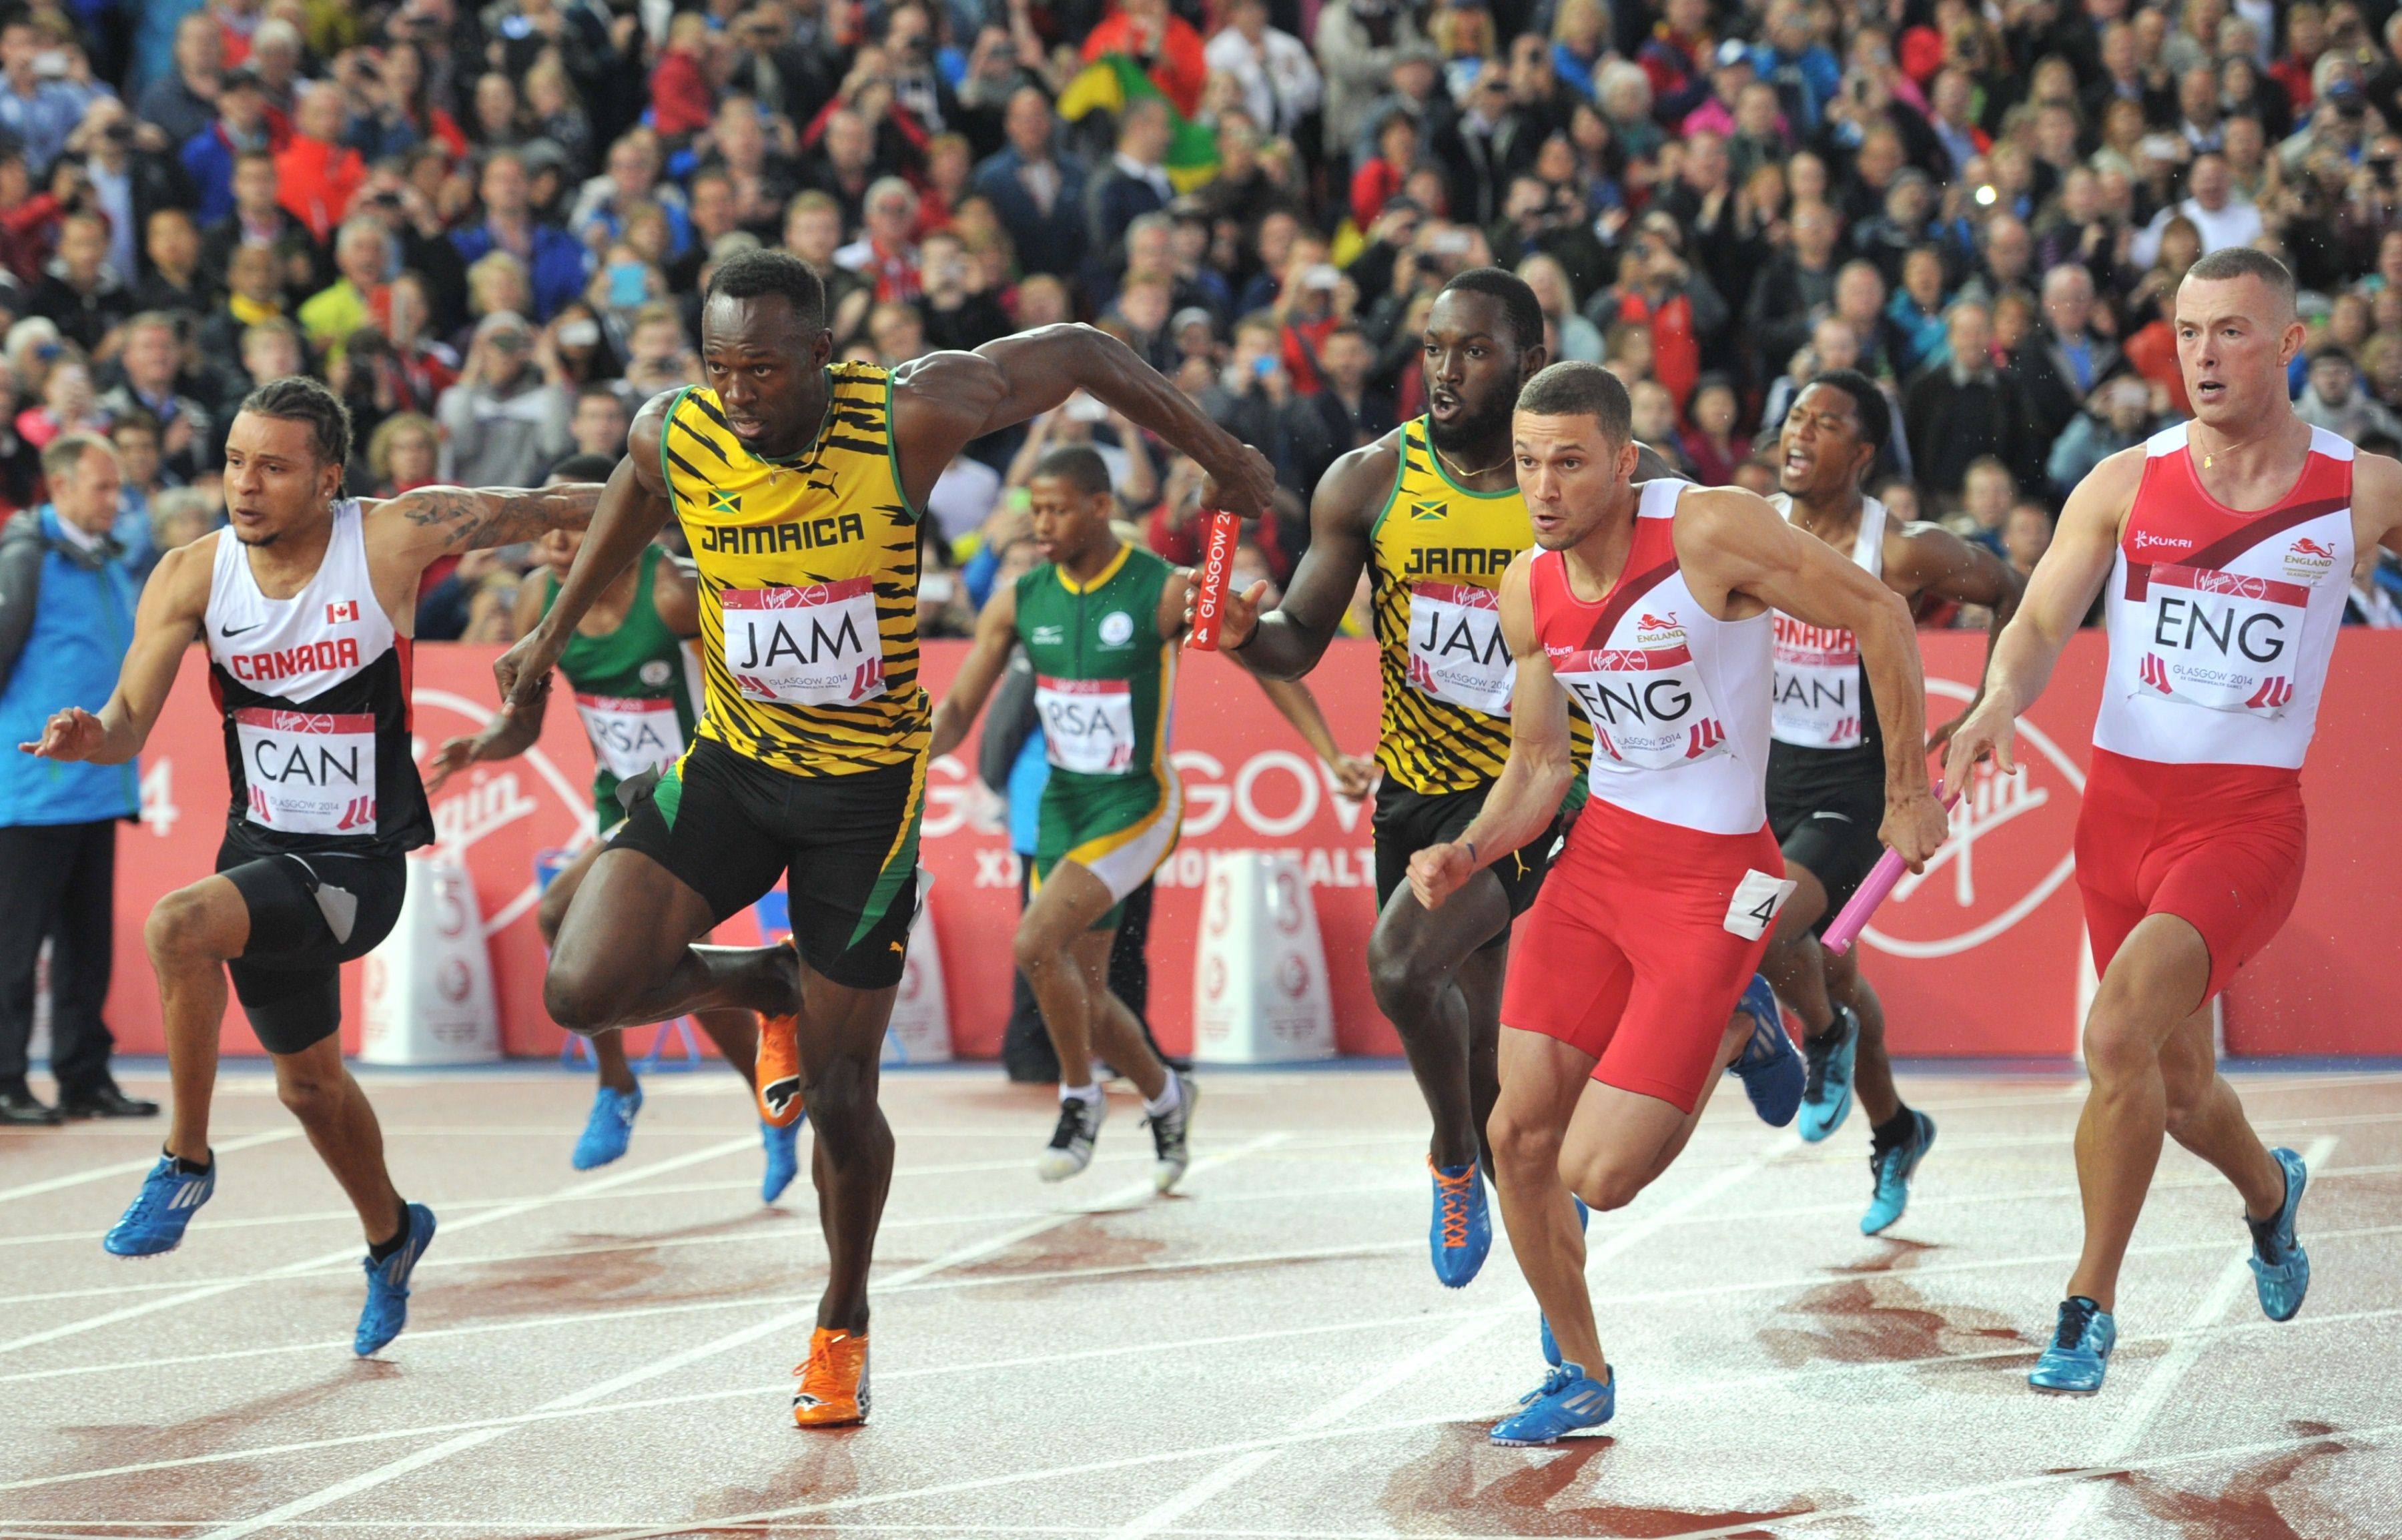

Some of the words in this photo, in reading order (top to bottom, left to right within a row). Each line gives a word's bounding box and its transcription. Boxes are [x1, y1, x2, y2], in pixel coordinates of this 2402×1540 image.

[702, 513, 865, 554] JAMAICA
[2148, 536, 2192, 548] KUKRI
[1405, 548, 1512, 574] JAMA
[2285, 555, 2332, 567] ENGLAND
[1200, 528, 1228, 619] GLASGOW
[2199, 570, 2231, 593] Virgin
[766, 588, 795, 609] Virgin
[1458, 586, 1487, 609] Virgin
[740, 610, 863, 669] JAM
[1197, 628, 1208, 644] 4
[1637, 629, 1685, 643] ENGLAND
[1773, 617, 1856, 651] ANADA
[2155, 597, 2285, 663] ENG
[232, 638, 360, 680] CANADA
[1550, 645, 1573, 656] KUKRI
[769, 677, 822, 686] GLASGOW
[826, 673, 847, 684] 2014
[1437, 669, 1487, 687] GLASGOW
[1491, 679, 1509, 690] 2014
[2172, 665, 2228, 680] GLASGOW
[2231, 674, 2253, 685] 2014
[1571, 679, 1692, 726] ENG
[1048, 701, 1116, 737] RSA
[592, 716, 665, 752] RSA
[1613, 735, 1655, 747] GLASGOW
[1659, 733, 1681, 745] 2014
[255, 739, 362, 786] CAN
[319, 802, 340, 811] 2014
[1749, 893, 1778, 928] 4
